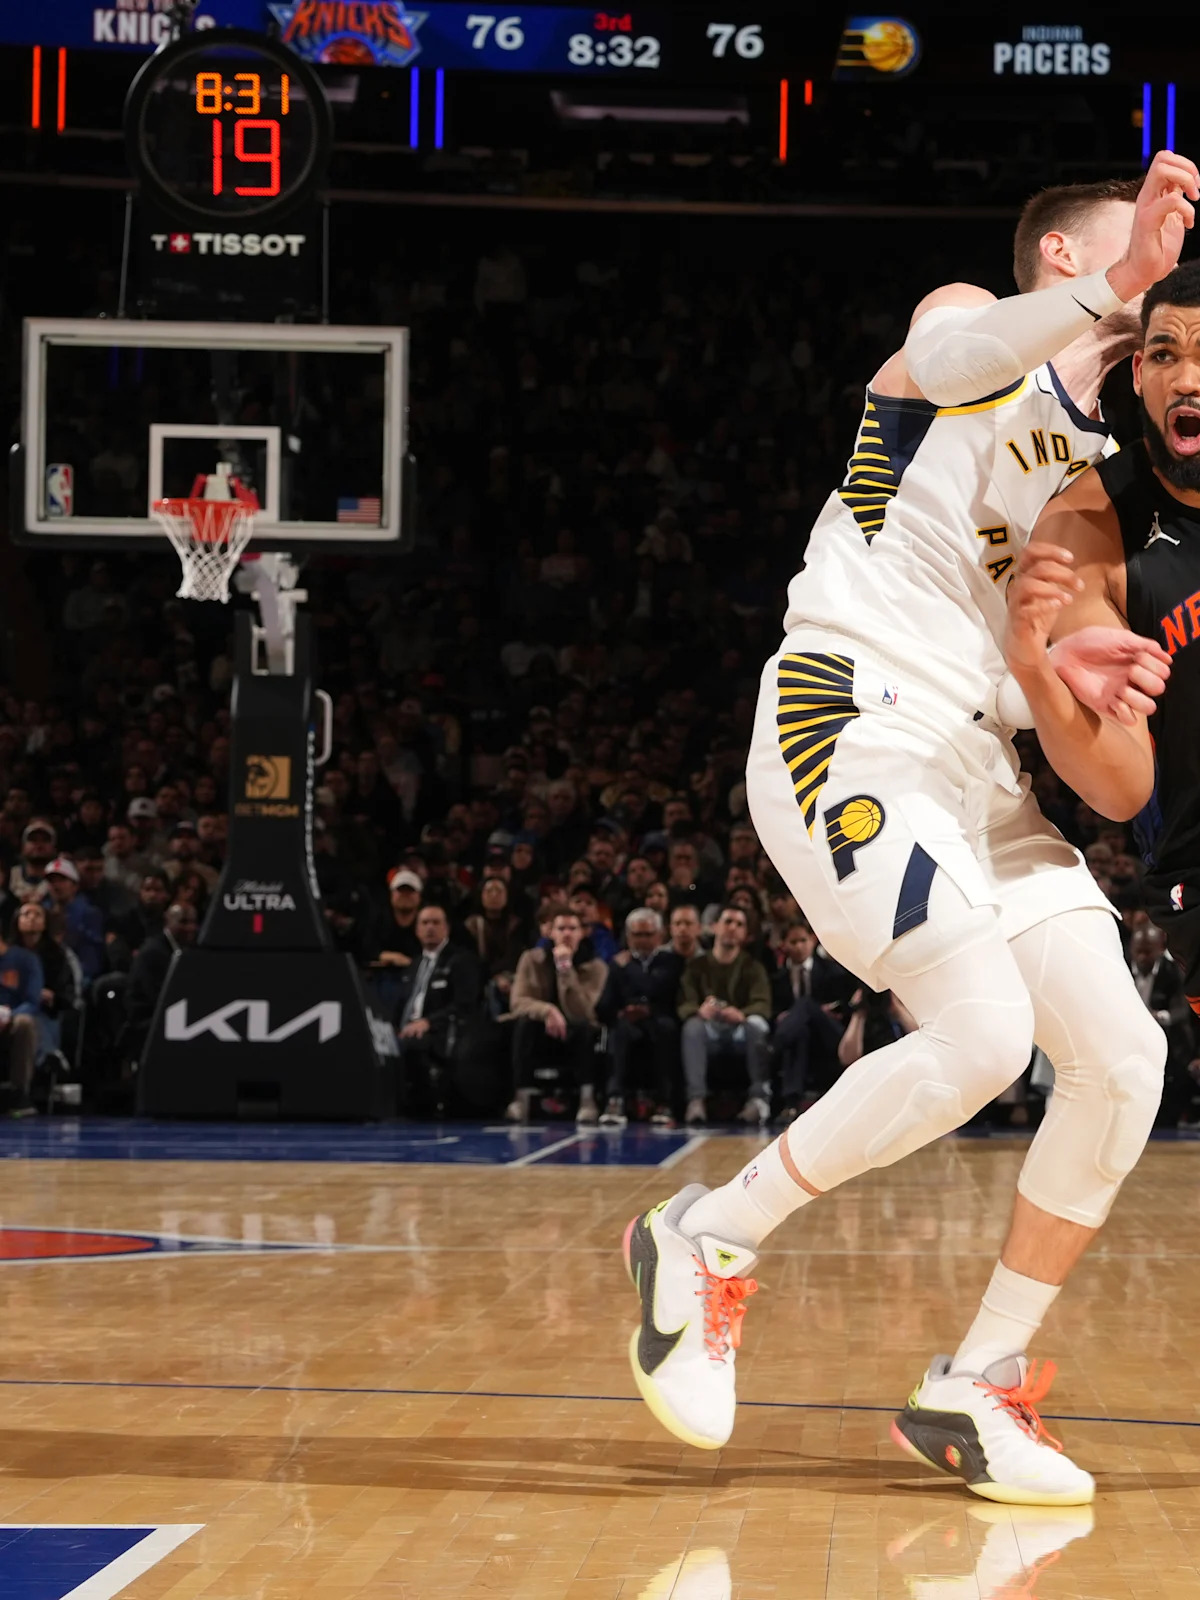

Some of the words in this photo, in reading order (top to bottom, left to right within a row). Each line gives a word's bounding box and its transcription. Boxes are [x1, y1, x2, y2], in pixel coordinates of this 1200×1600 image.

[594, 13, 632, 31] 3rd
[1022, 25, 1082, 42] INDIANA
[466, 14, 525, 50] 76
[568, 34, 660, 69] 8:32
[706, 23, 764, 59] 76
[994, 42, 1110, 75] PACERS
[196, 72, 289, 115] 8:31
[212, 118, 280, 196] 19
[193, 233, 305, 256] TISSOT
[223, 893, 297, 911] ULTRA
[165, 999, 341, 1043] KIA
